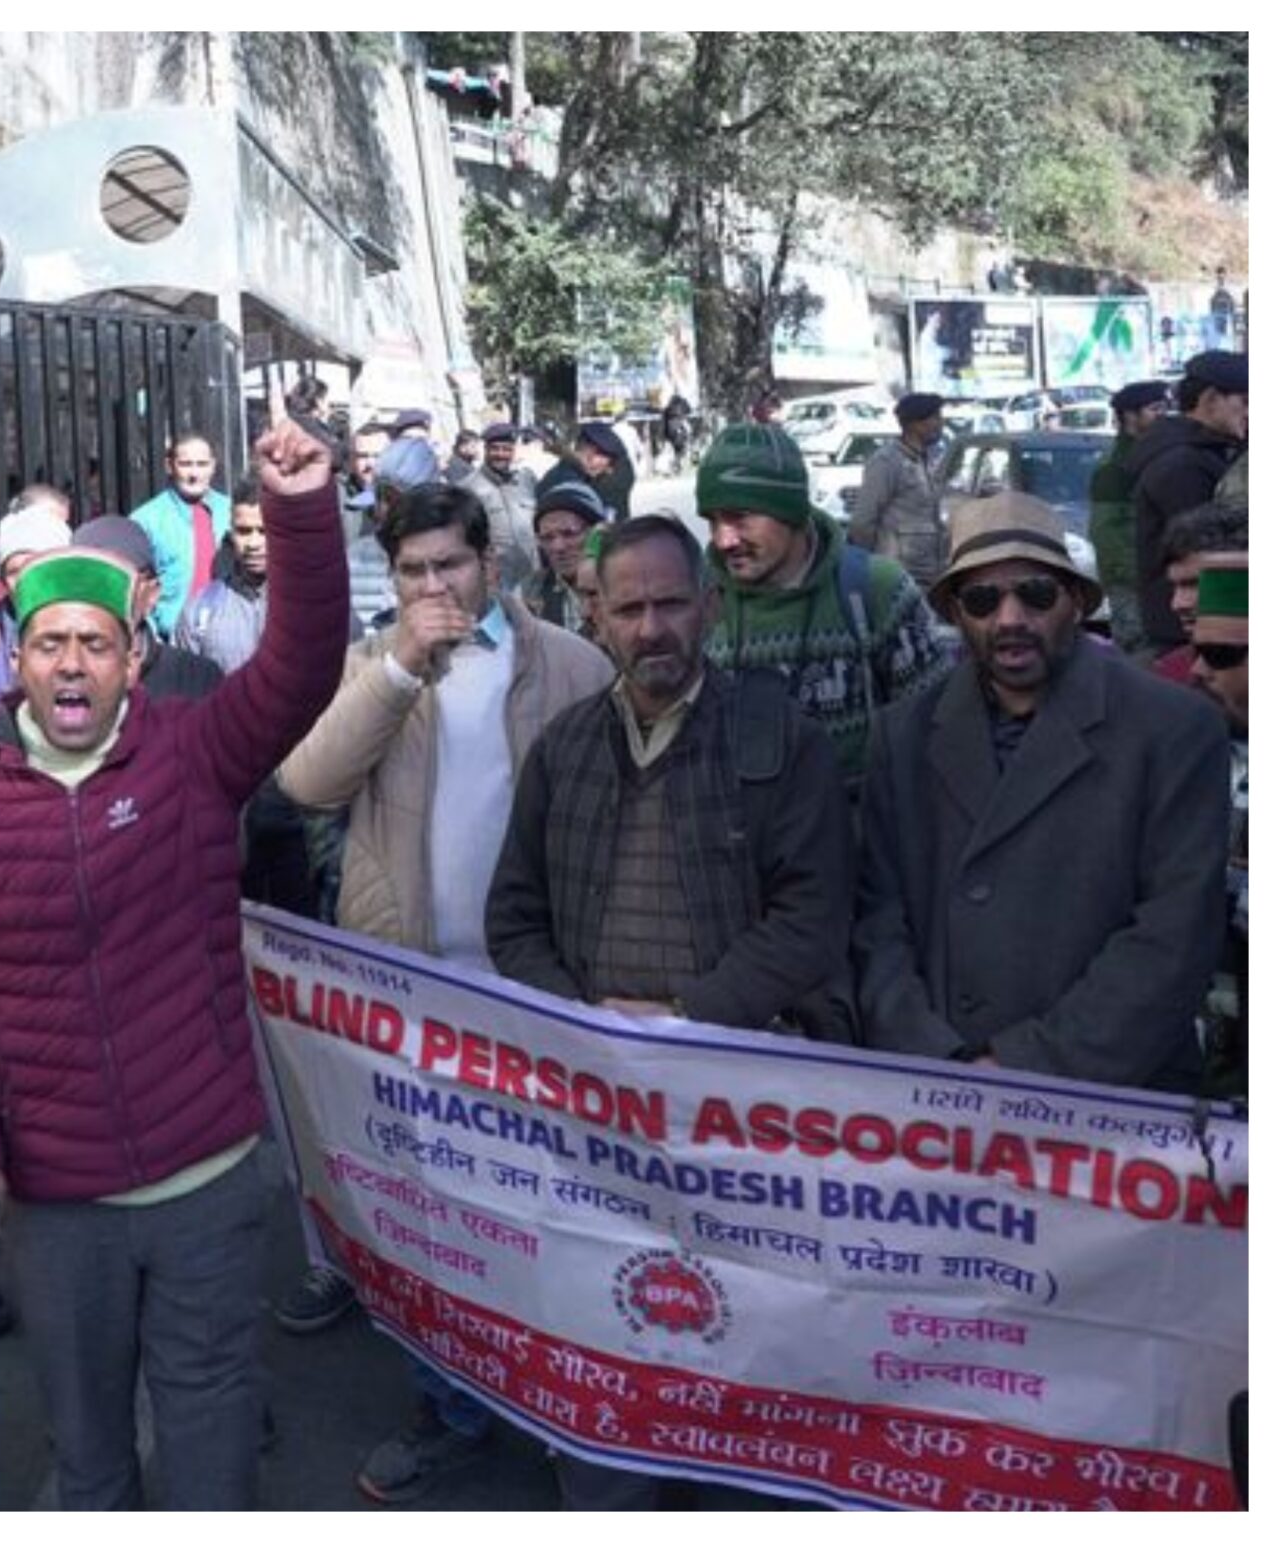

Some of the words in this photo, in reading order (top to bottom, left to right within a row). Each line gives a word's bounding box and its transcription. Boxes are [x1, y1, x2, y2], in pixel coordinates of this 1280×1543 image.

[358, 963, 412, 996] 11914
[253, 964, 405, 1054] BLIND
[419, 1017, 666, 1143] PERSON
[691, 1096, 1248, 1230] ASSOCIATION
[373, 1073, 578, 1160] HIMACHAL
[586, 1135, 805, 1211] PRADESH
[820, 1178, 1036, 1245] BRANCH
[460, 1208, 539, 1260] एकता
[487, 1159, 540, 1196] जन
[551, 1174, 651, 1221] संगठन
[693, 1210, 823, 1263] हिमाचल
[839, 1237, 923, 1275] प्रदेश
[646, 1284, 701, 1312] BPA
[659, 1376, 728, 1416] नहीं
[741, 1394, 861, 1436] मांगना
[884, 1417, 966, 1457] झुक
[985, 1440, 1056, 1480] कर
